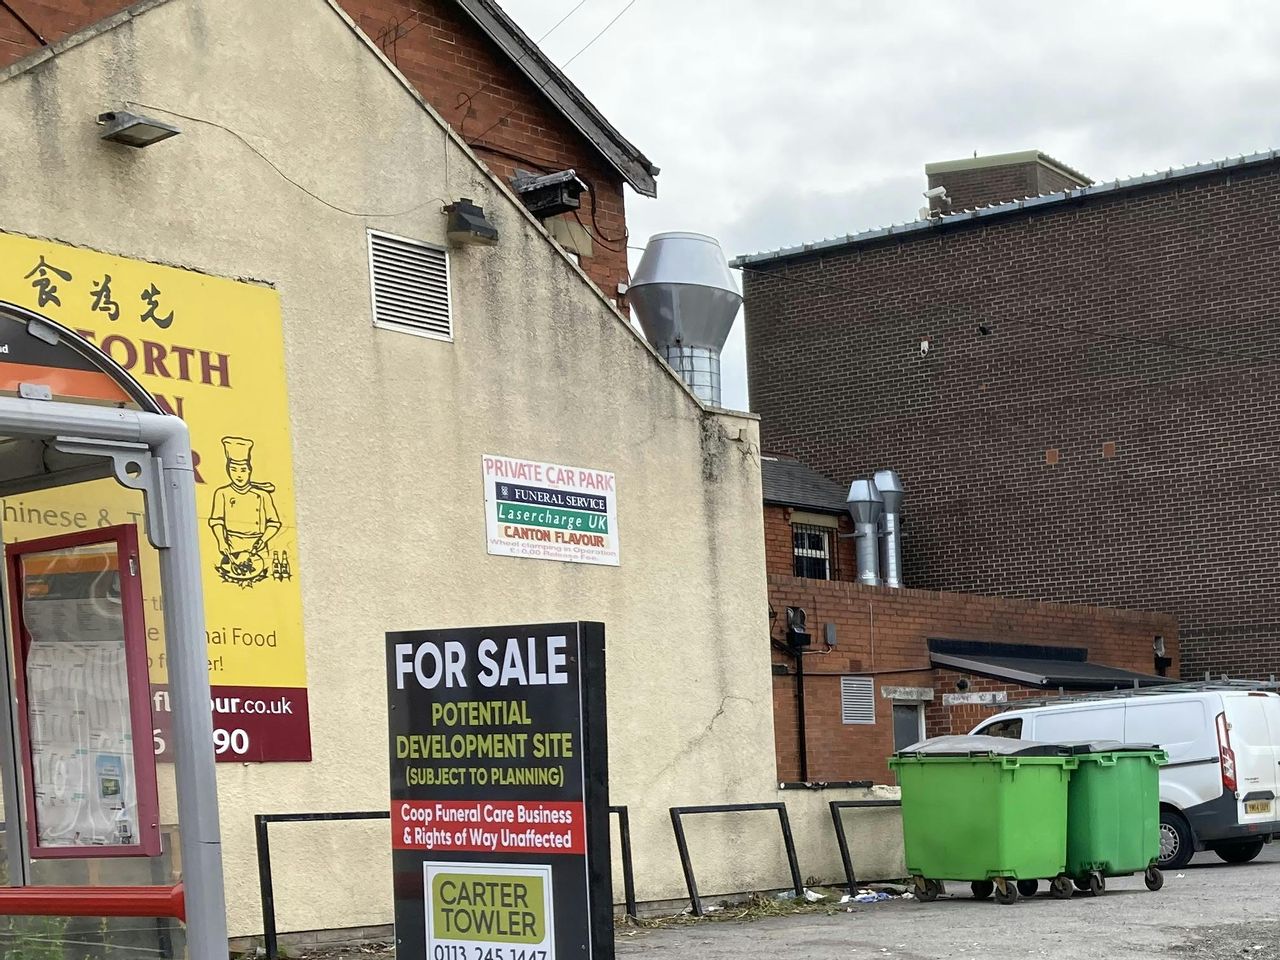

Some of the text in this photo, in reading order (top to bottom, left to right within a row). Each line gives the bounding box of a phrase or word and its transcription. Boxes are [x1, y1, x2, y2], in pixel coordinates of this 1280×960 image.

[485, 458, 614, 492] PRIVATE CAR PARK
[514, 488, 564, 504] FUNERAL
[566, 495, 605, 510] SERVICE
[2, 500, 87, 528] hinese
[98, 508, 112, 526] &
[498, 504, 607, 530] Lasercharge UK
[504, 526, 605, 548] CANTON FLAVOUR
[232, 627, 277, 648] Food
[395, 635, 568, 690] FOR SALE
[431, 700, 532, 727] POTENTIAL
[213, 728, 249, 755] 90
[396, 733, 573, 759] DEVELOPMENT SITE
[406, 765, 564, 788] (SUBJECT TO PLANNING)
[401, 804, 572, 827] Coop Funeral Care Business
[403, 827, 572, 851] & Rights of Way Unaffected
[439, 880, 529, 909] CARTER
[441, 908, 537, 937] TOWLER
